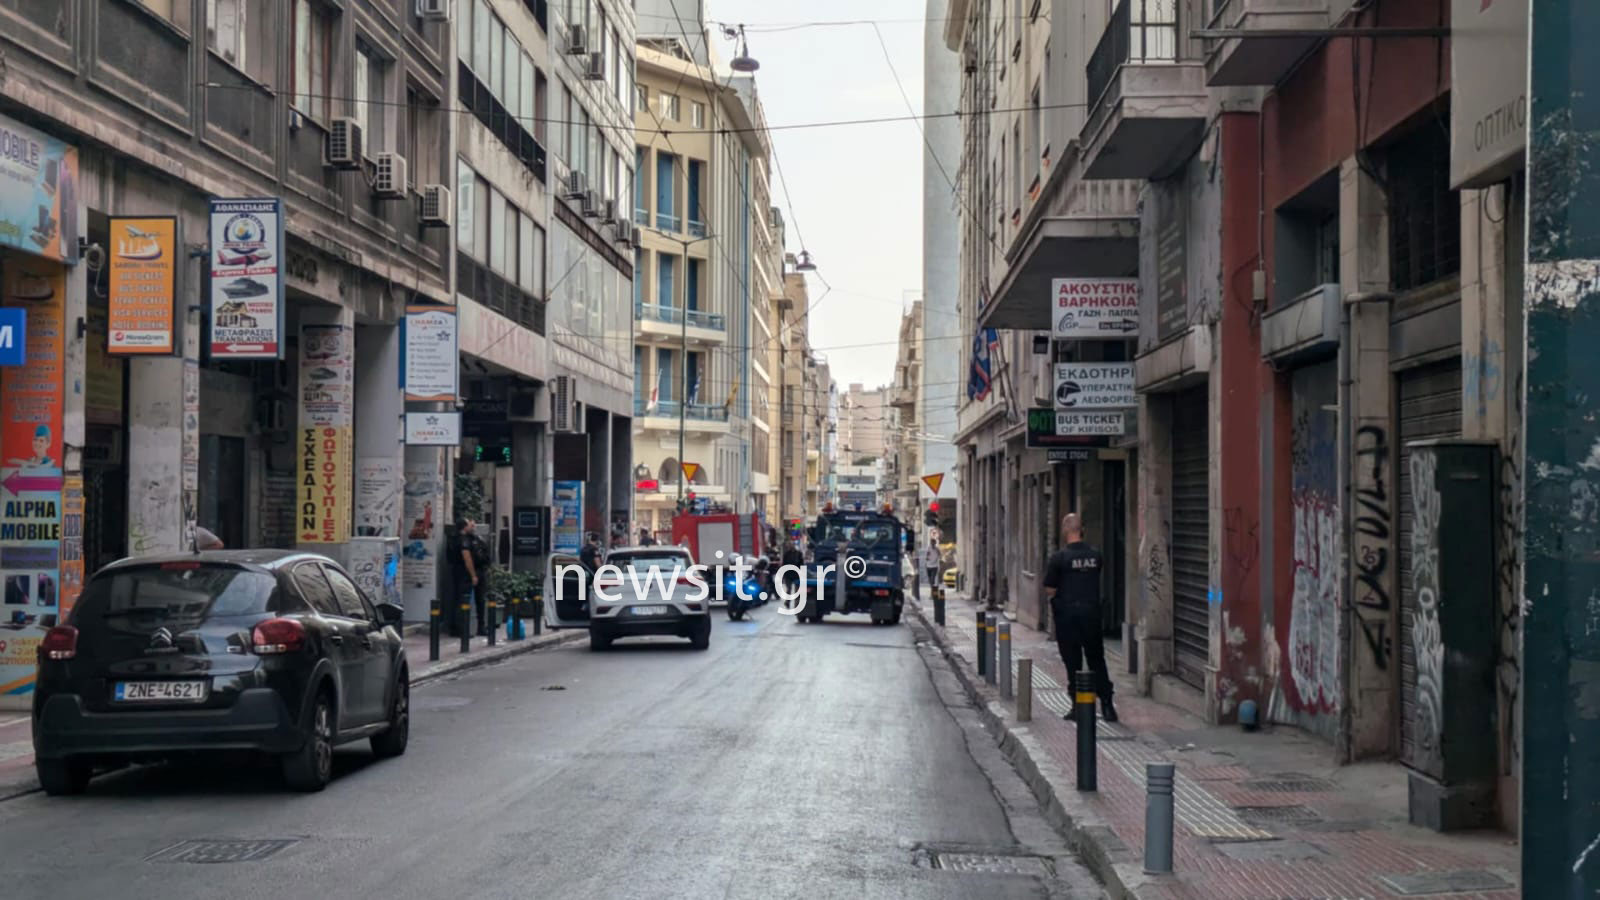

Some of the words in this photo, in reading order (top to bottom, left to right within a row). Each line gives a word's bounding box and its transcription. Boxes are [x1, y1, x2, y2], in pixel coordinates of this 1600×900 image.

[0, 127, 39, 168] OBILE
[215, 203, 274, 212] ΑΘΑΝΑΣΙΑΔΗΣ
[1059, 283, 1138, 295] ΑΚΟΥΣΤΙΚ
[1058, 415, 1080, 425] BUS
[1083, 414, 1122, 425] TICKET
[303, 429, 316, 531] ΣΧΕΔΙΩΝ
[323, 428, 337, 542] ΦΩΤΟΤΥΠΙΕΣ
[5, 501, 56, 518] ALPHA
[0, 523, 60, 541] MOBILE
